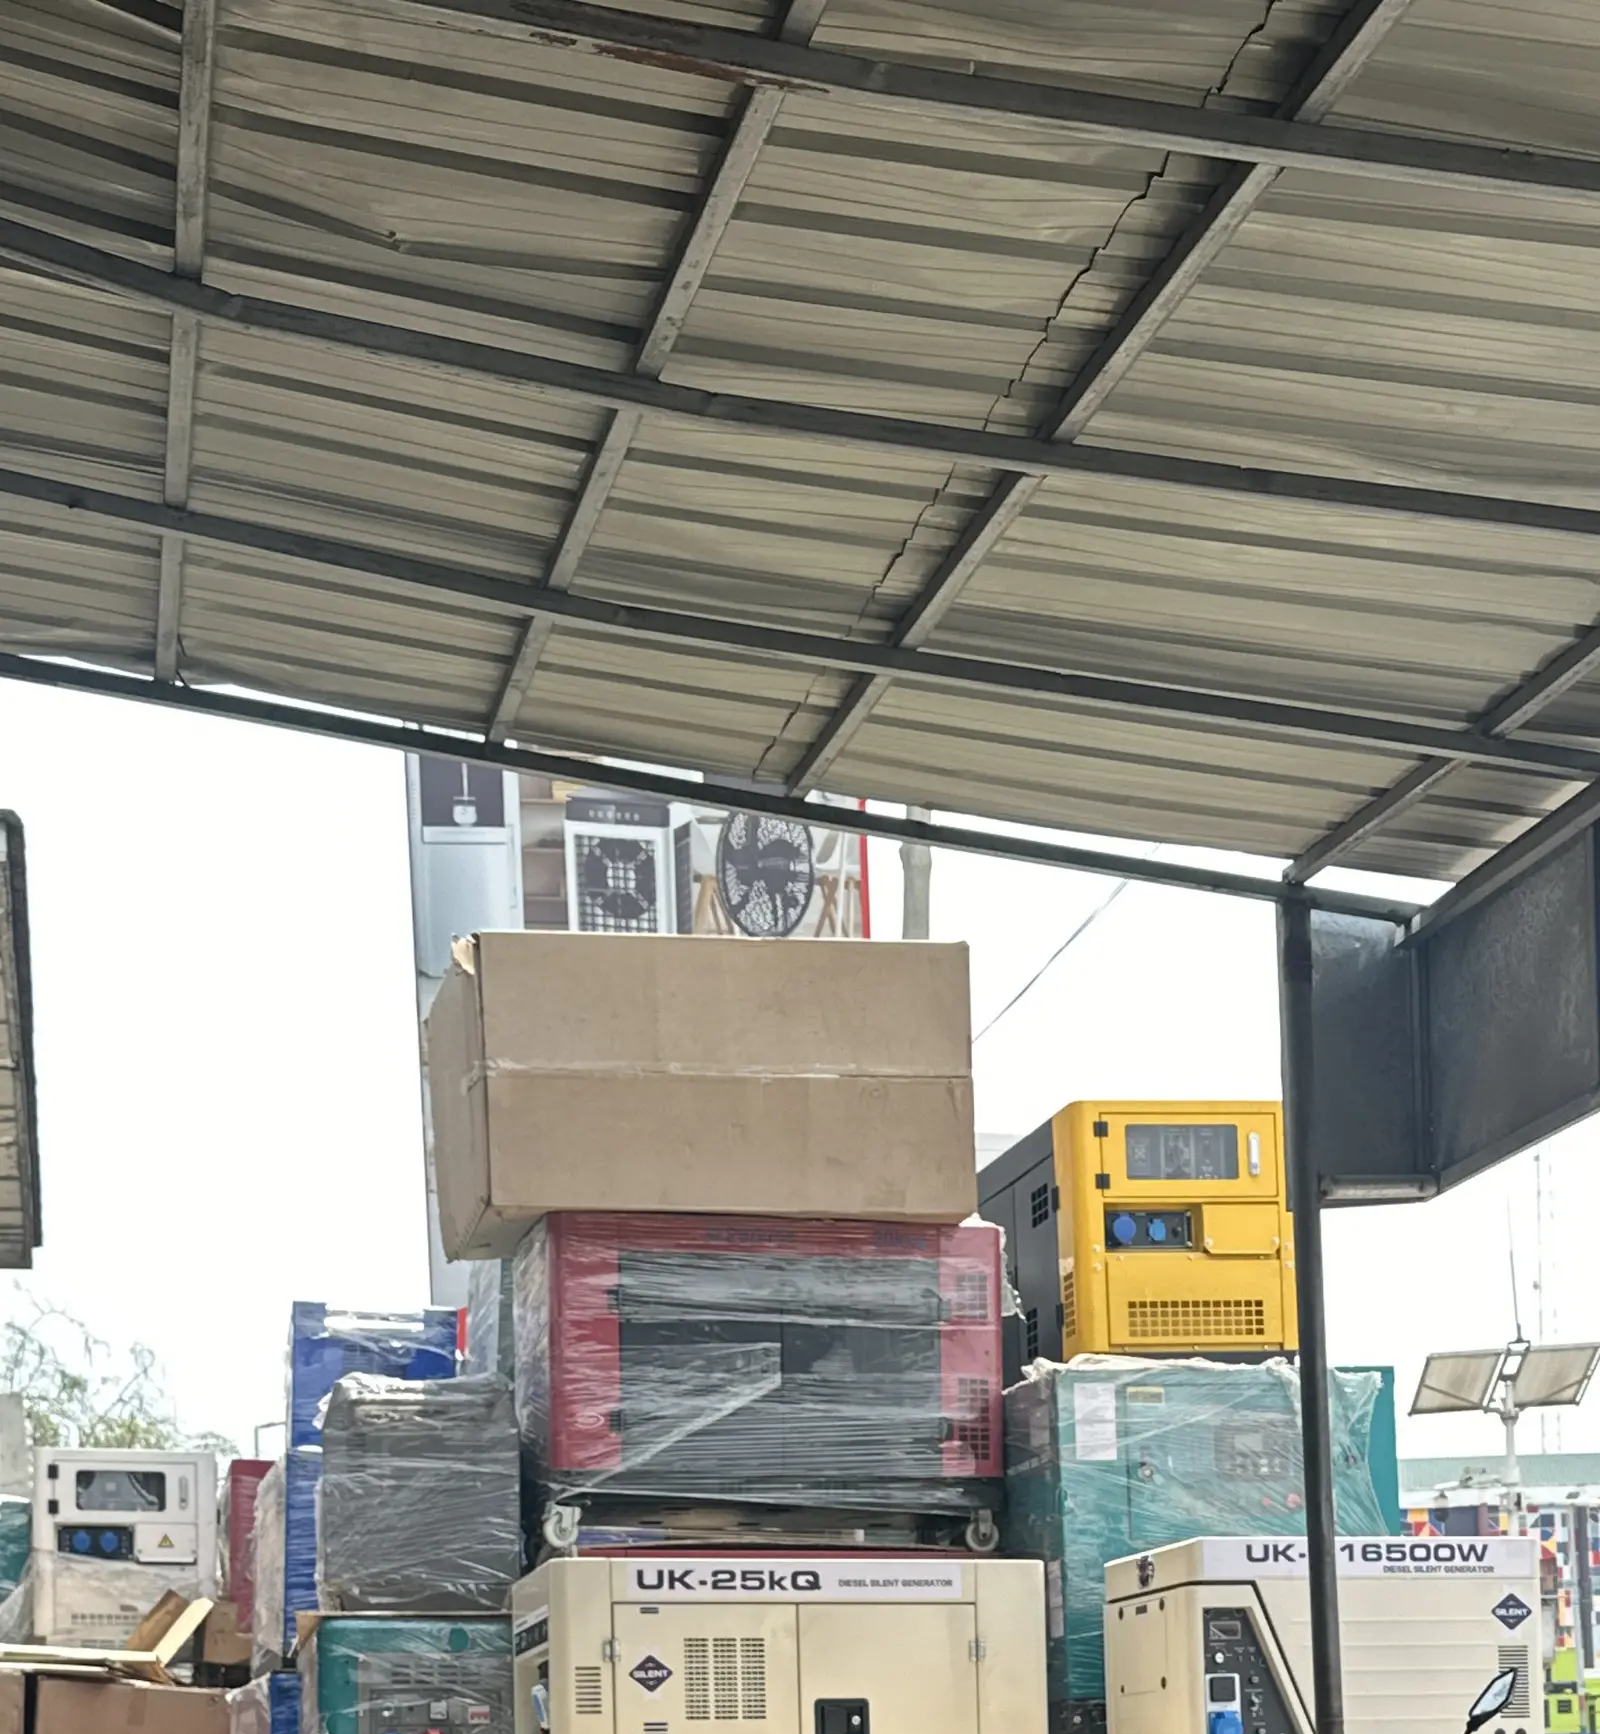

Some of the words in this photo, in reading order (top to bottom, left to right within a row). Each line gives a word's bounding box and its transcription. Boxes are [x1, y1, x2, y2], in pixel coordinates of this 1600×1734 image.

[636, 1569, 822, 1591] UK-25kQ
[1495, 1607, 1529, 1617] SILENT
[632, 1669, 669, 1679] SILENT
